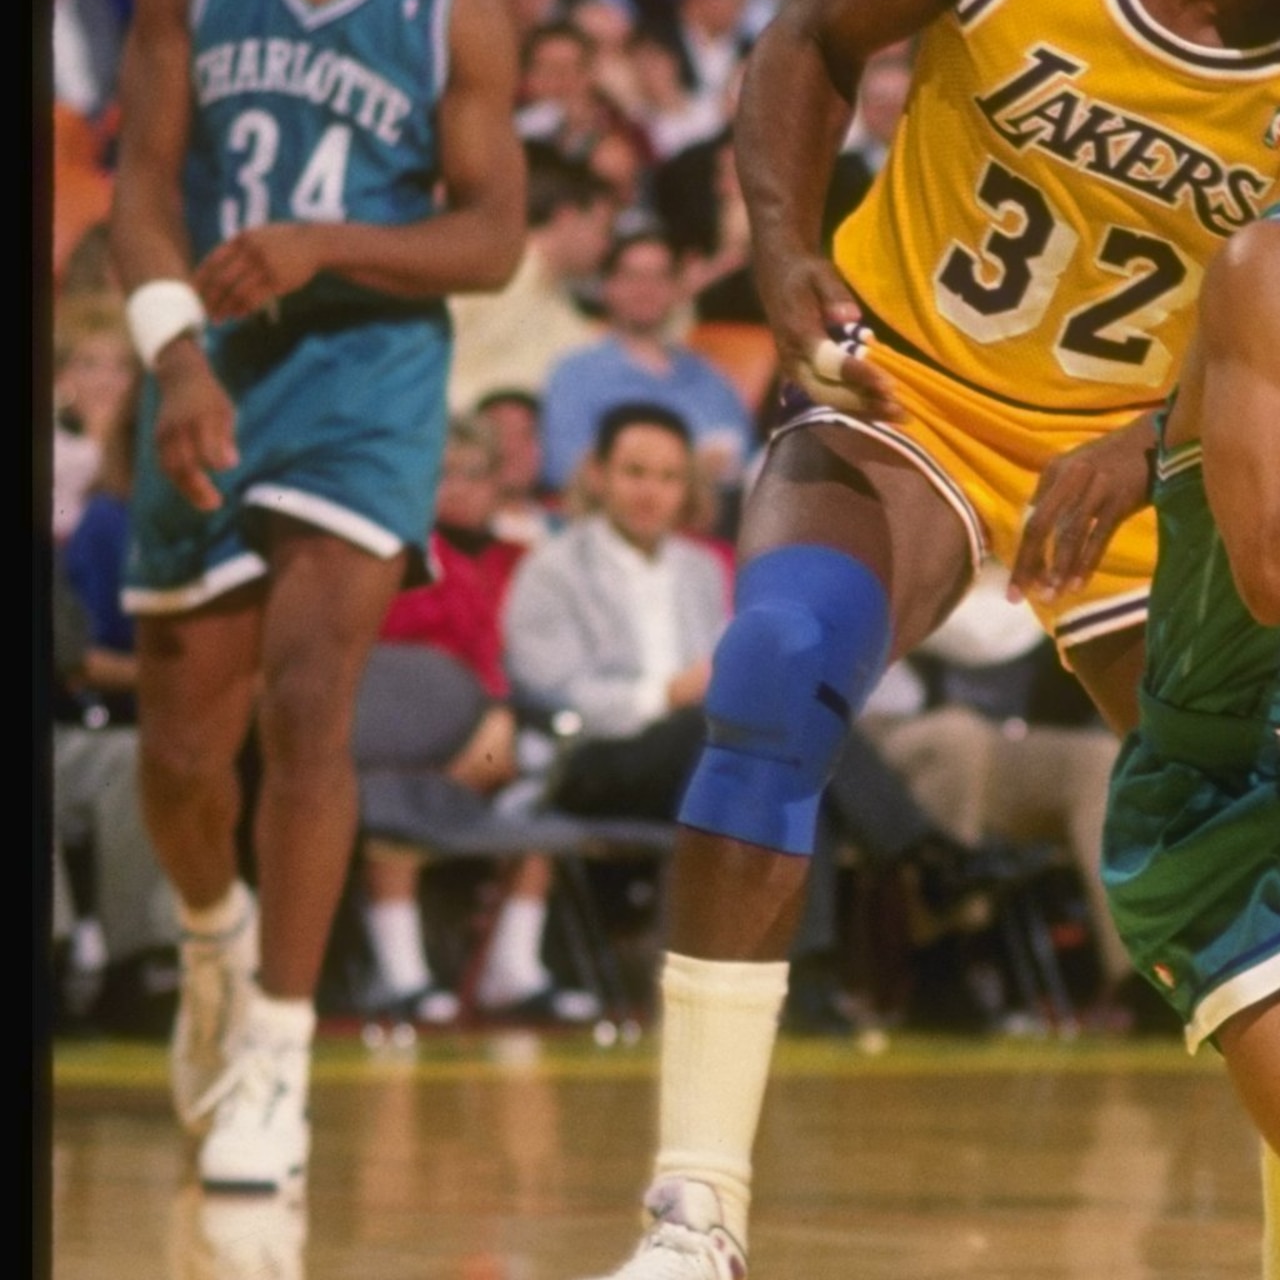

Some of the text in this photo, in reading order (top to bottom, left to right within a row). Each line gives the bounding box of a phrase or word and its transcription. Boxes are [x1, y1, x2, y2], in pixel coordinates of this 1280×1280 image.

[196, 37, 411, 146] CHARLOTTE
[976, 44, 1272, 239] LAKERS
[219, 108, 351, 239] 34
[935, 157, 1200, 382] 32
